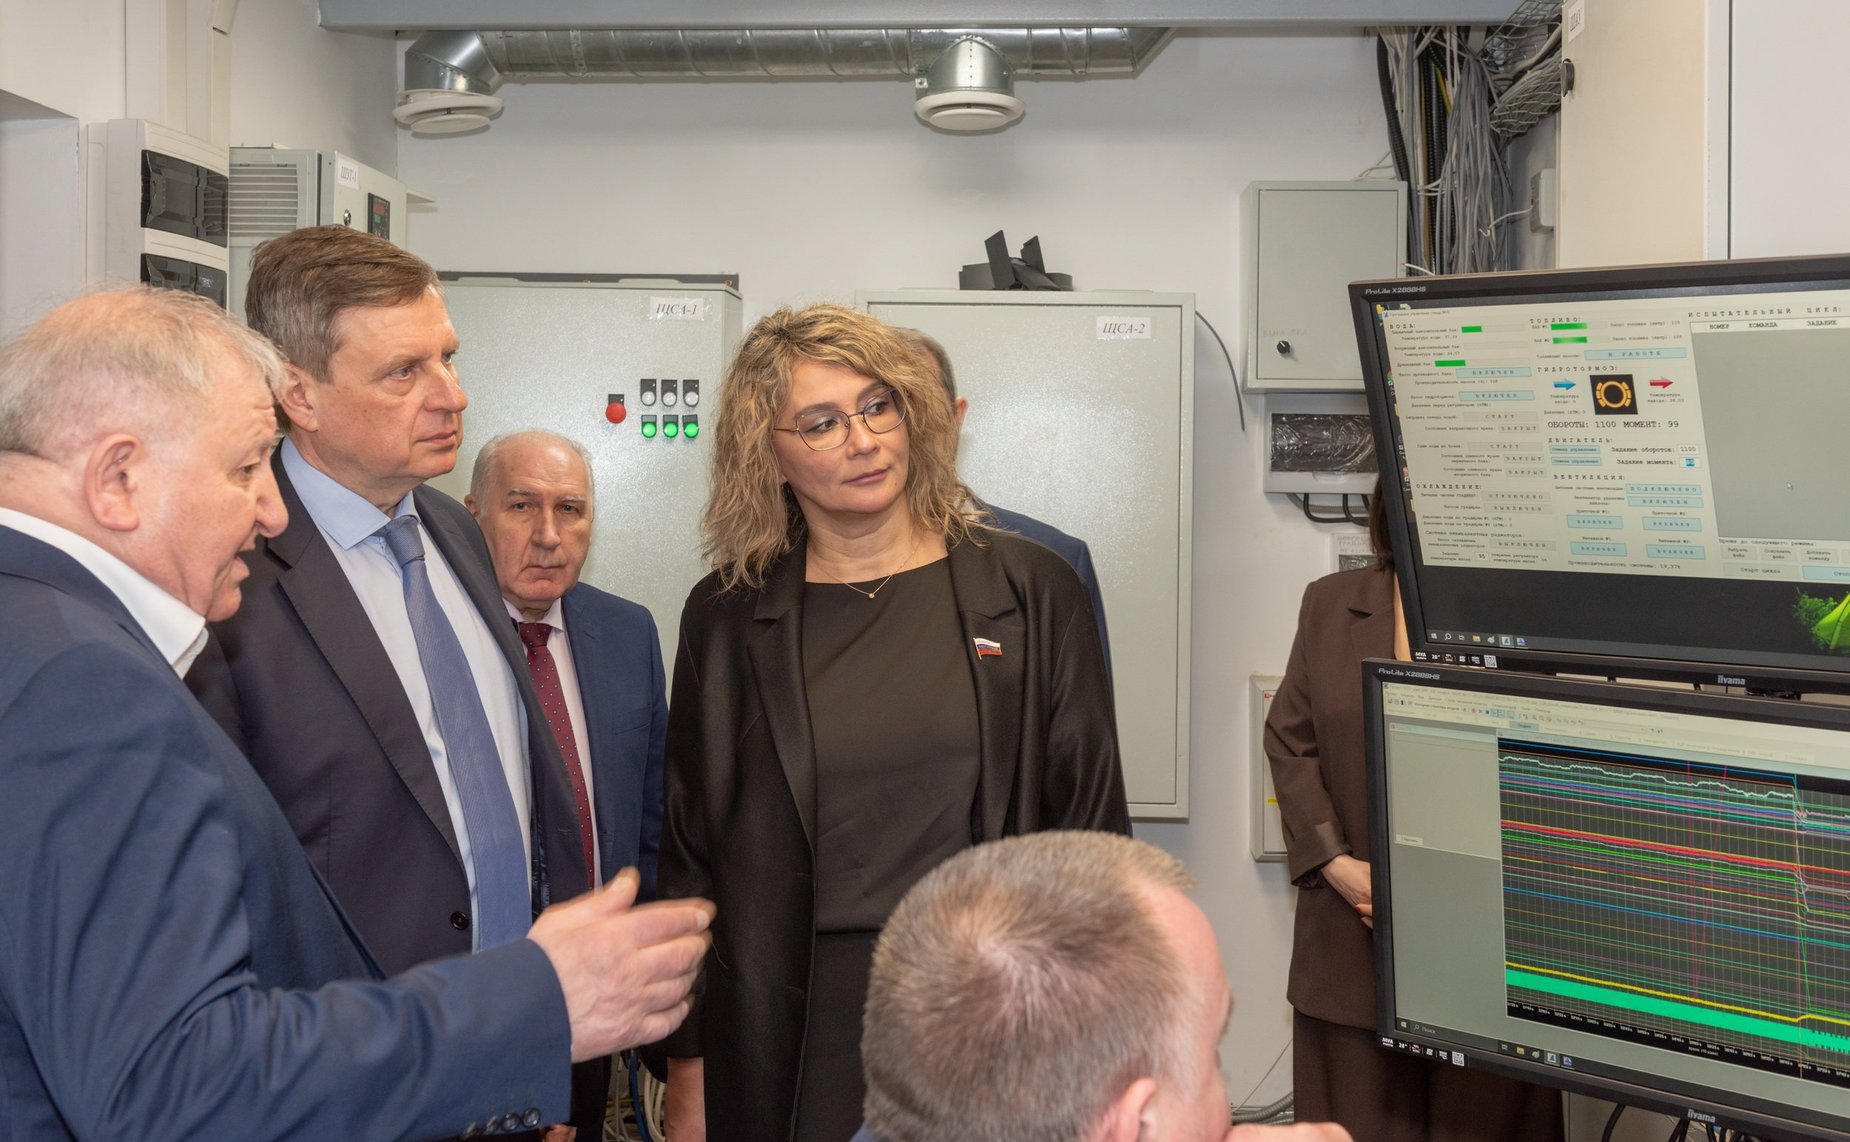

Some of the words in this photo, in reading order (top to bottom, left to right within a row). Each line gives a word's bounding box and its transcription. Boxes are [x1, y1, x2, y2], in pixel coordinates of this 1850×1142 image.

[656, 303, 698, 316] ЩСА-1
[1102, 322, 1146, 335] ЩСА-2
[1641, 446, 1676, 454] оборотов:
[1378, 667, 1405, 676] ProLite
[1717, 674, 1746, 685] iiyama
[1687, 1108, 1716, 1124] iiyama
